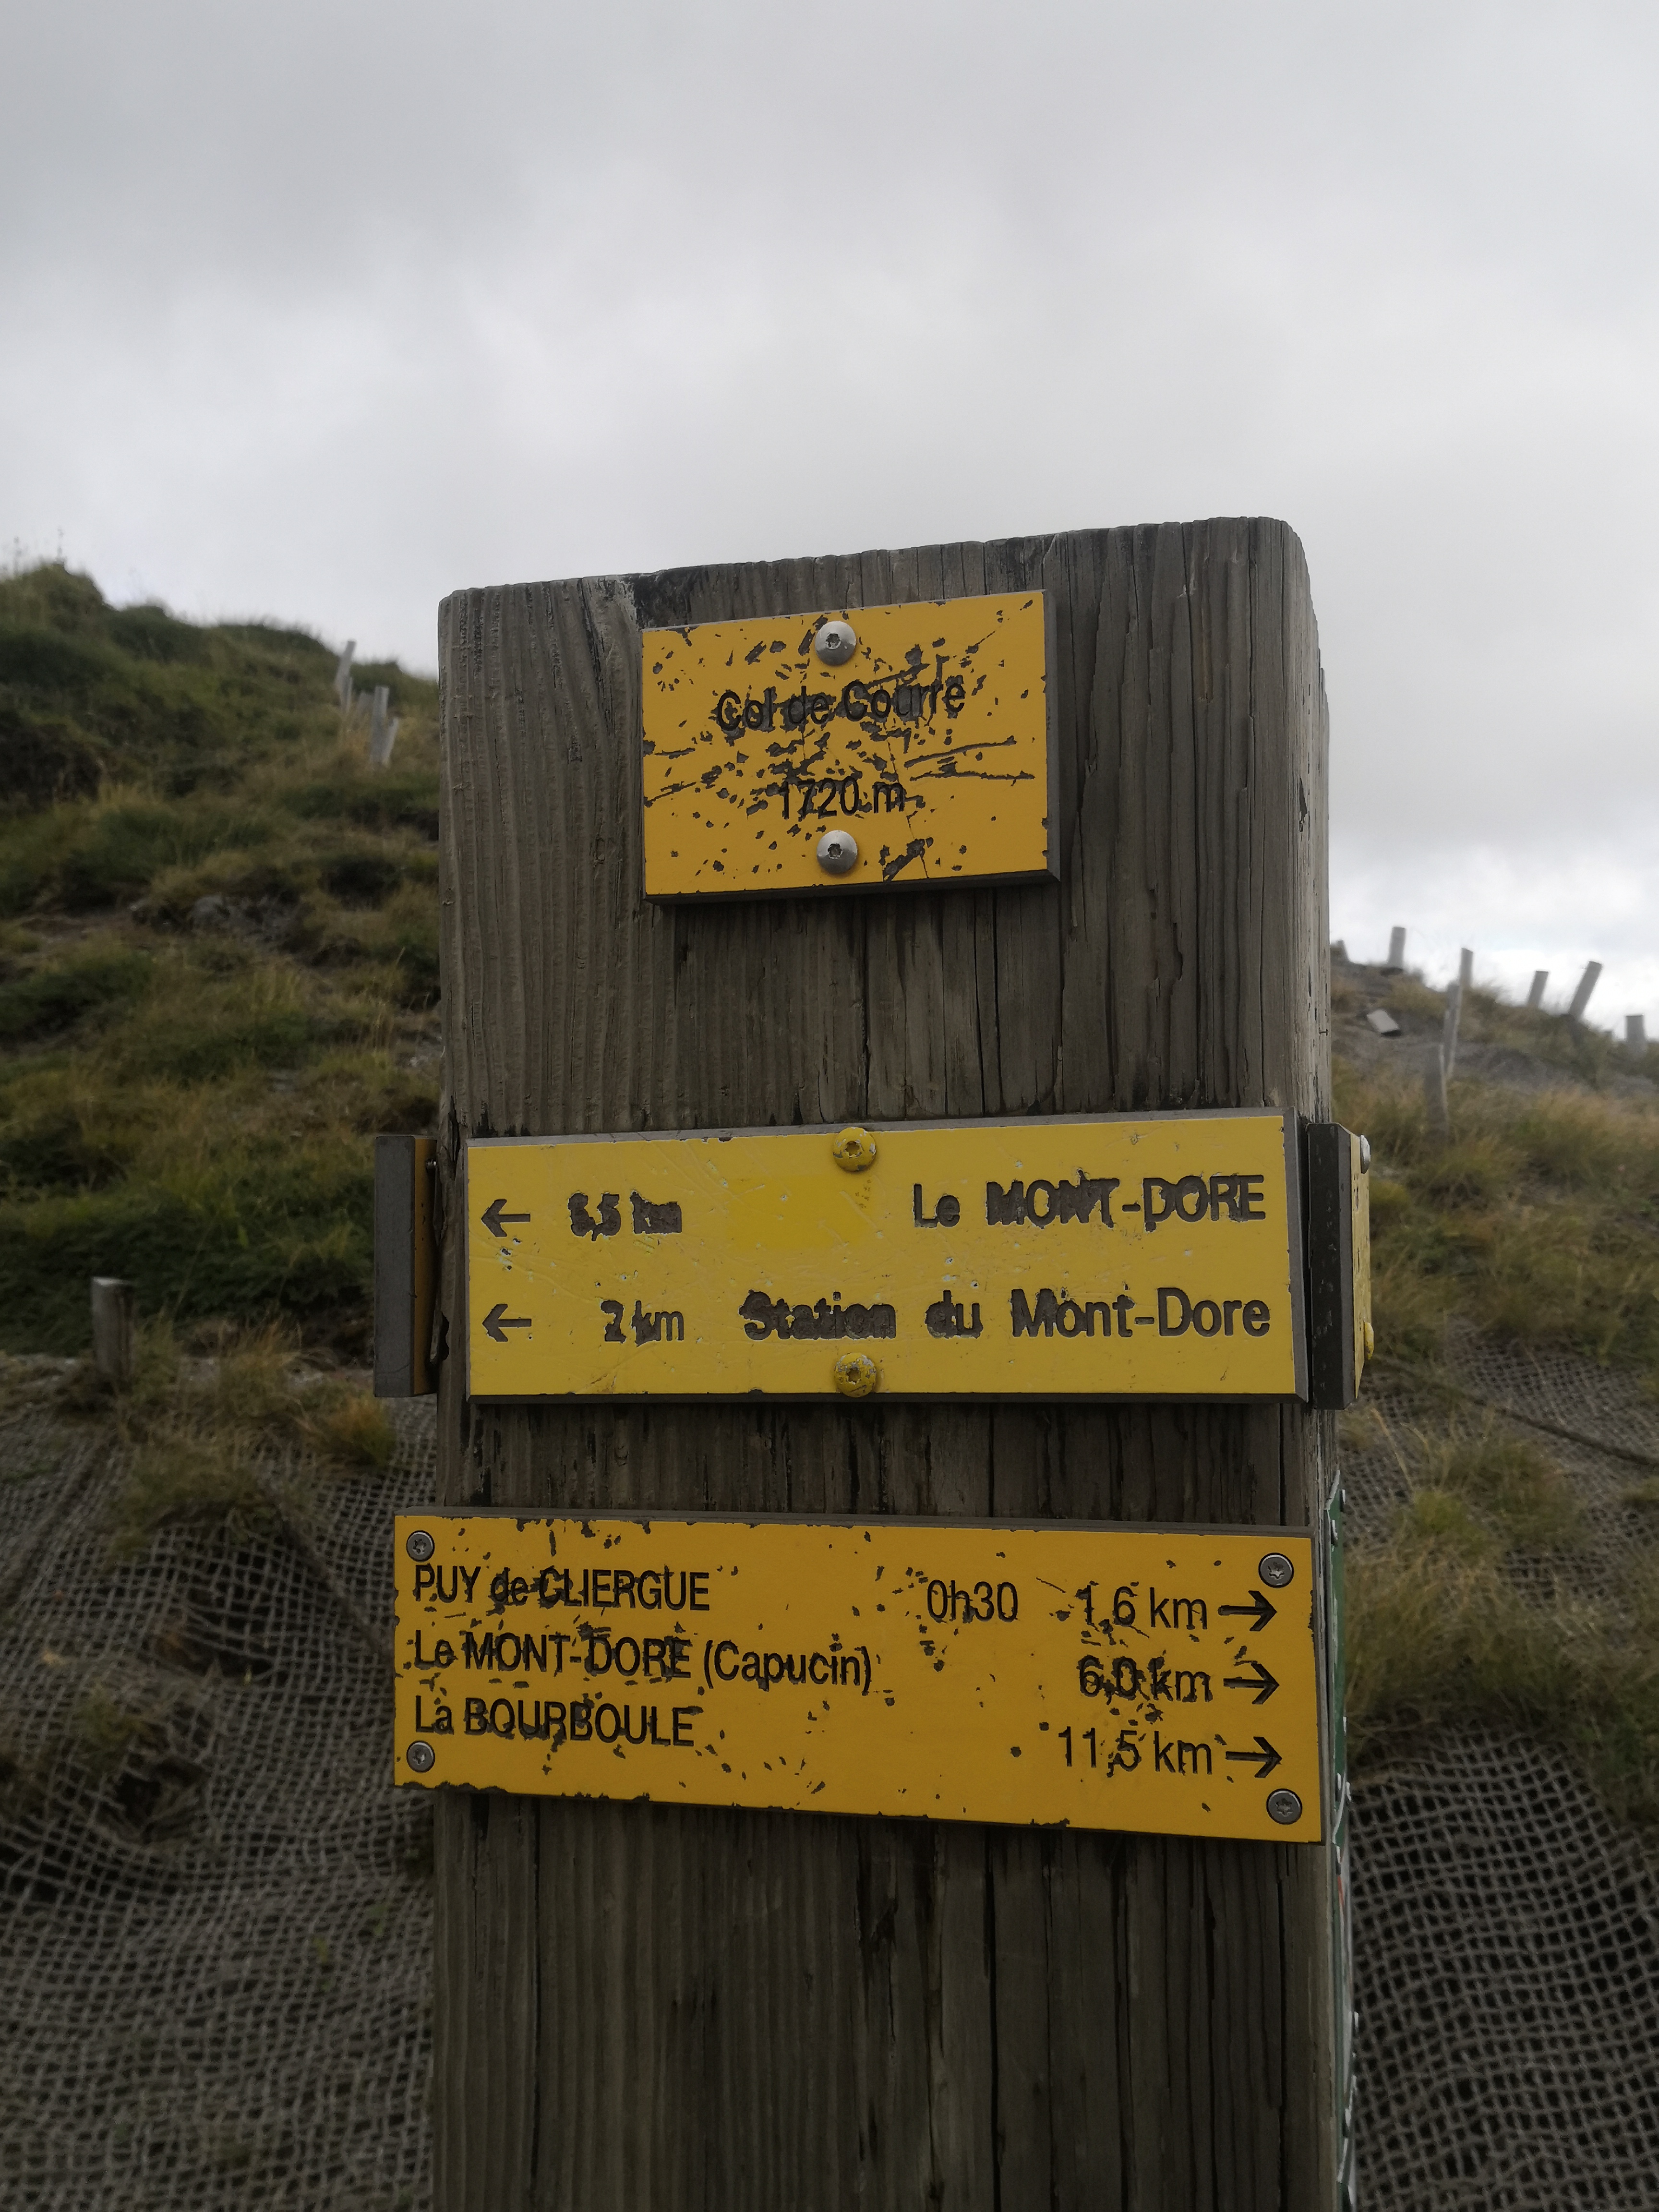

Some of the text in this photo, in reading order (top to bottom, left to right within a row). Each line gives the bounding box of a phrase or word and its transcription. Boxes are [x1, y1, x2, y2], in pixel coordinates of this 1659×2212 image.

[716, 678, 966, 732] Col de Courre
[780, 777, 905, 821] 1720 m
[913, 1183, 961, 1228] Le
[985, 1174, 1266, 1230] MONT-DORE
[601, 1287, 1271, 1345] 2 km Station du Mont-Dore
[414, 1565, 481, 1603] PUY
[490, 1574, 529, 1606] de
[539, 1567, 710, 1612] CLIERGUE
[927, 1579, 1019, 1623] 0h30
[1150, 1587, 1208, 1629] km
[414, 1630, 456, 1670] Le
[464, 1631, 691, 1678] MONT-DORE
[703, 1640, 873, 1695] (Capucin)
[1152, 1659, 1212, 1702] km
[414, 1695, 1213, 1778] La BOURBOULE 11,5 km
